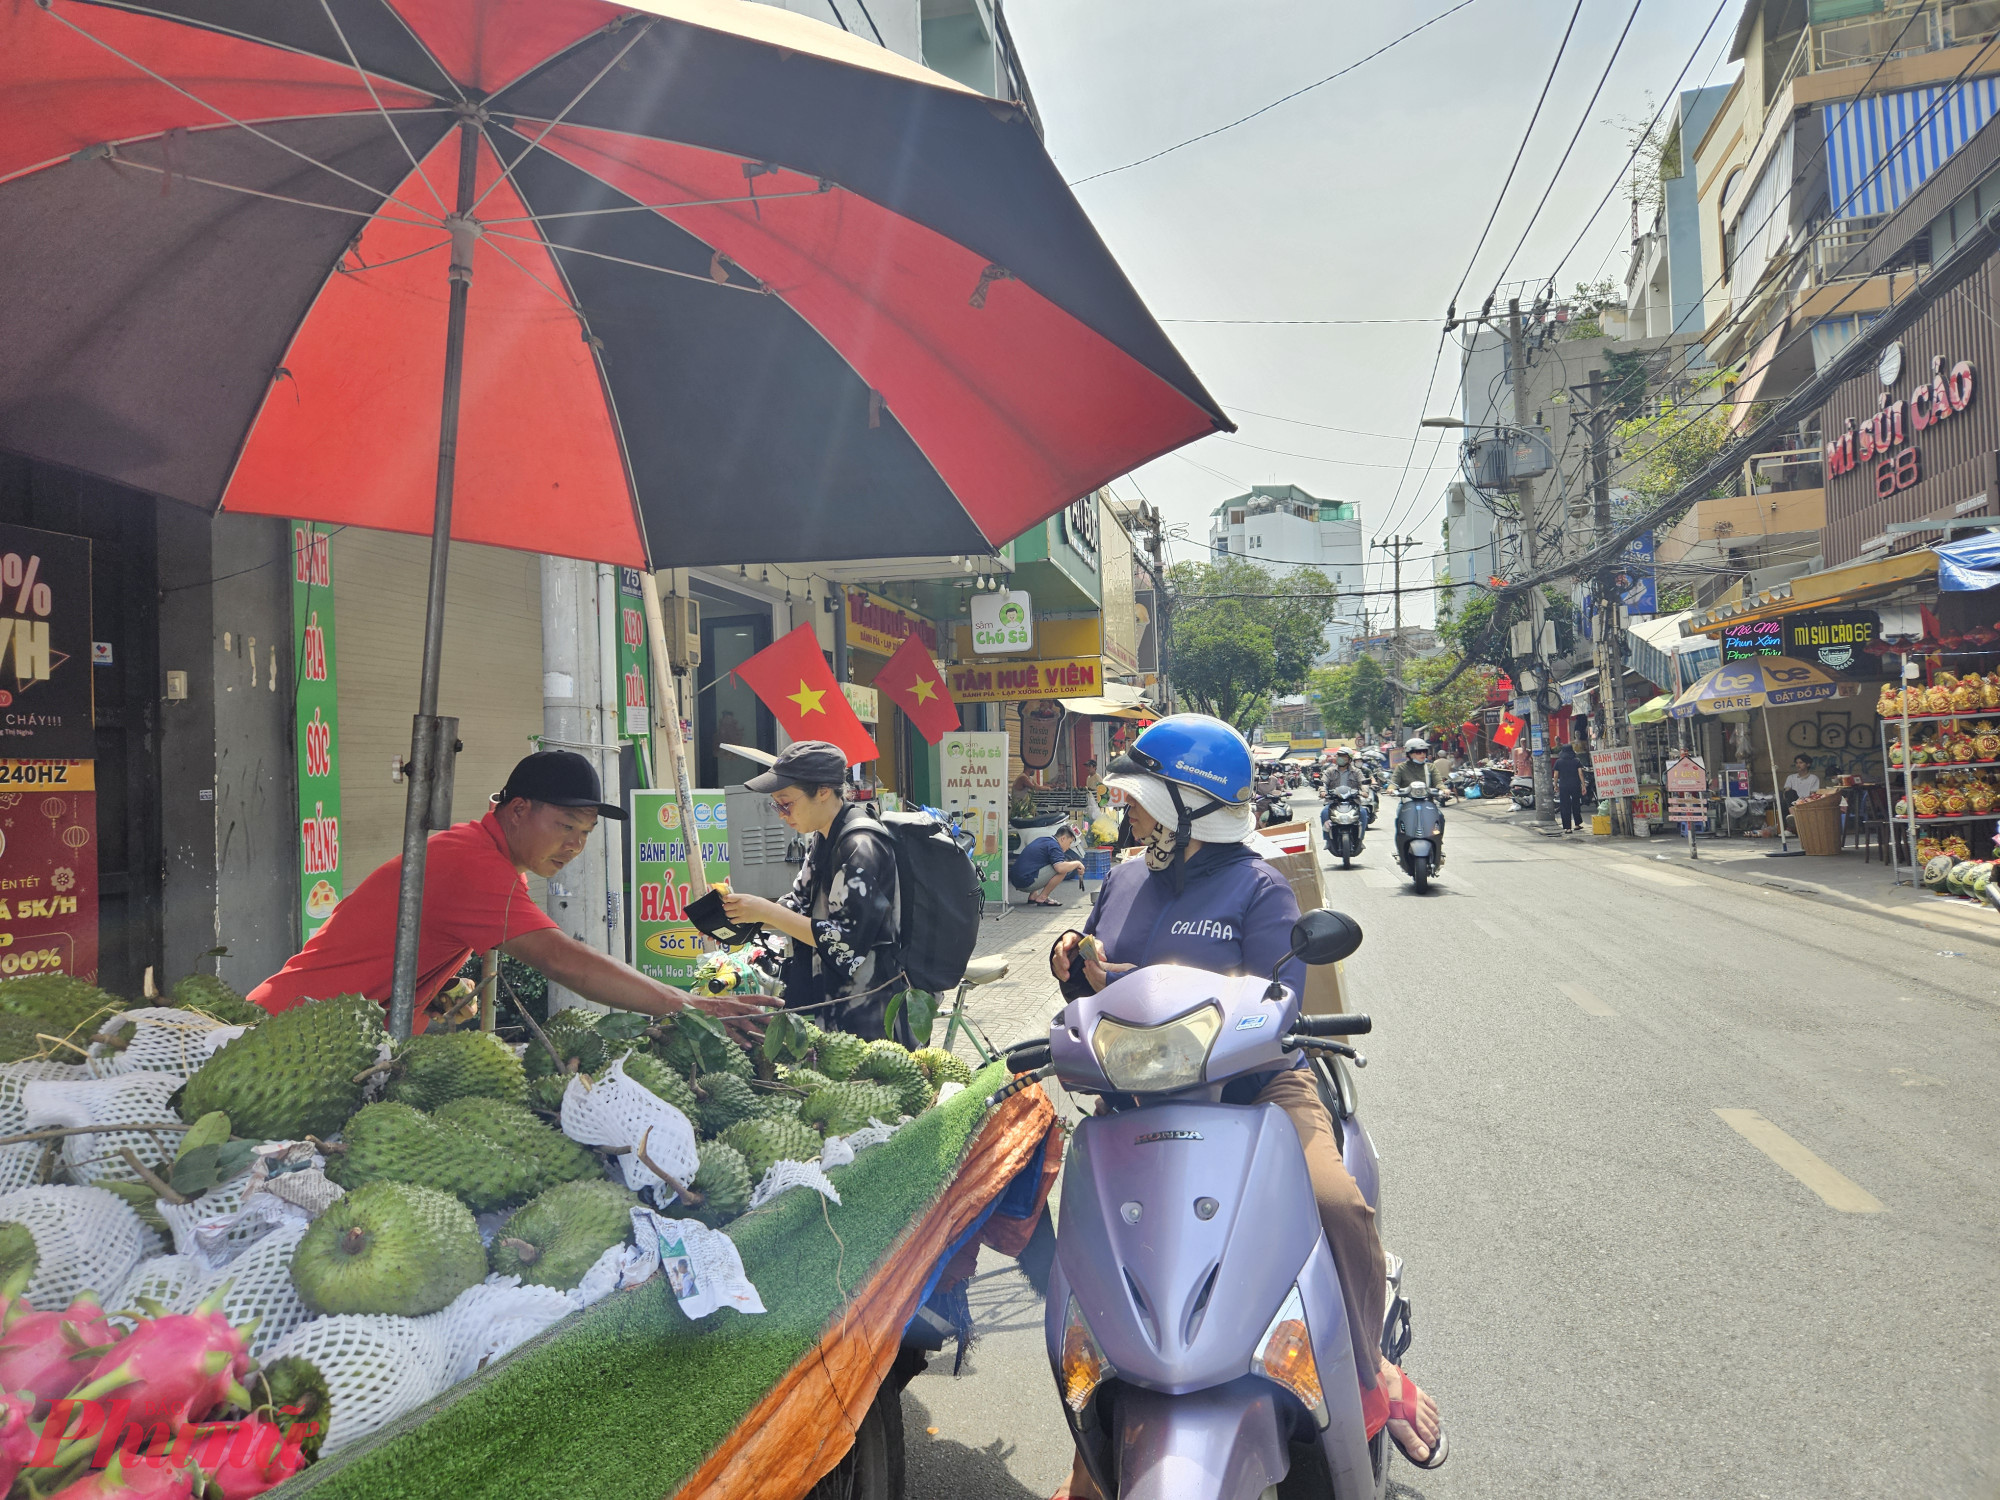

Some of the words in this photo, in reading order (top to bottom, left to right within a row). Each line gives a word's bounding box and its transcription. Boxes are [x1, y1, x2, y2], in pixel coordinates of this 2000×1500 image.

[1876, 447, 1920, 498] 68
[295, 520, 330, 587] BÁNH
[623, 608, 643, 653] KẸO
[305, 610, 327, 682] PÍA
[1725, 637, 1753, 648] Phun
[952, 668, 992, 692] TÂN
[997, 664, 1039, 690] HUÊ
[1045, 662, 1094, 687] VIÊN
[1715, 672, 1755, 691] be
[1763, 666, 1811, 682] be
[1713, 697, 1734, 710] GIÁ
[1775, 690, 1794, 703] ĐẶT
[5, 712, 62, 726] CHÁY!!!
[306, 706, 330, 777] SÓC
[1593, 752, 1612, 764] BÁNH
[0, 765, 67, 783] 240HZ
[960, 765, 988, 775] SÂM
[1175, 760, 1228, 785] Sacombank
[1596, 765, 1617, 777] BÁNH
[947, 777, 972, 788] MÍA
[977, 778, 1001, 788] LAU
[303, 802, 339, 874] TRẮNG
[640, 838, 666, 862] BÁNH
[669, 837, 685, 862] PÍA
[701, 843, 714, 868] ẠP
[0, 877, 17, 889] ÊN
[19, 875, 40, 888] TẾT
[17, 895, 77, 919] 5K/H
[1171, 919, 1233, 941] CALIFAA
[660, 935, 685, 949] Sóc
[666, 965, 683, 978] Hoa
[1135, 1131, 1204, 1145] HONDA
